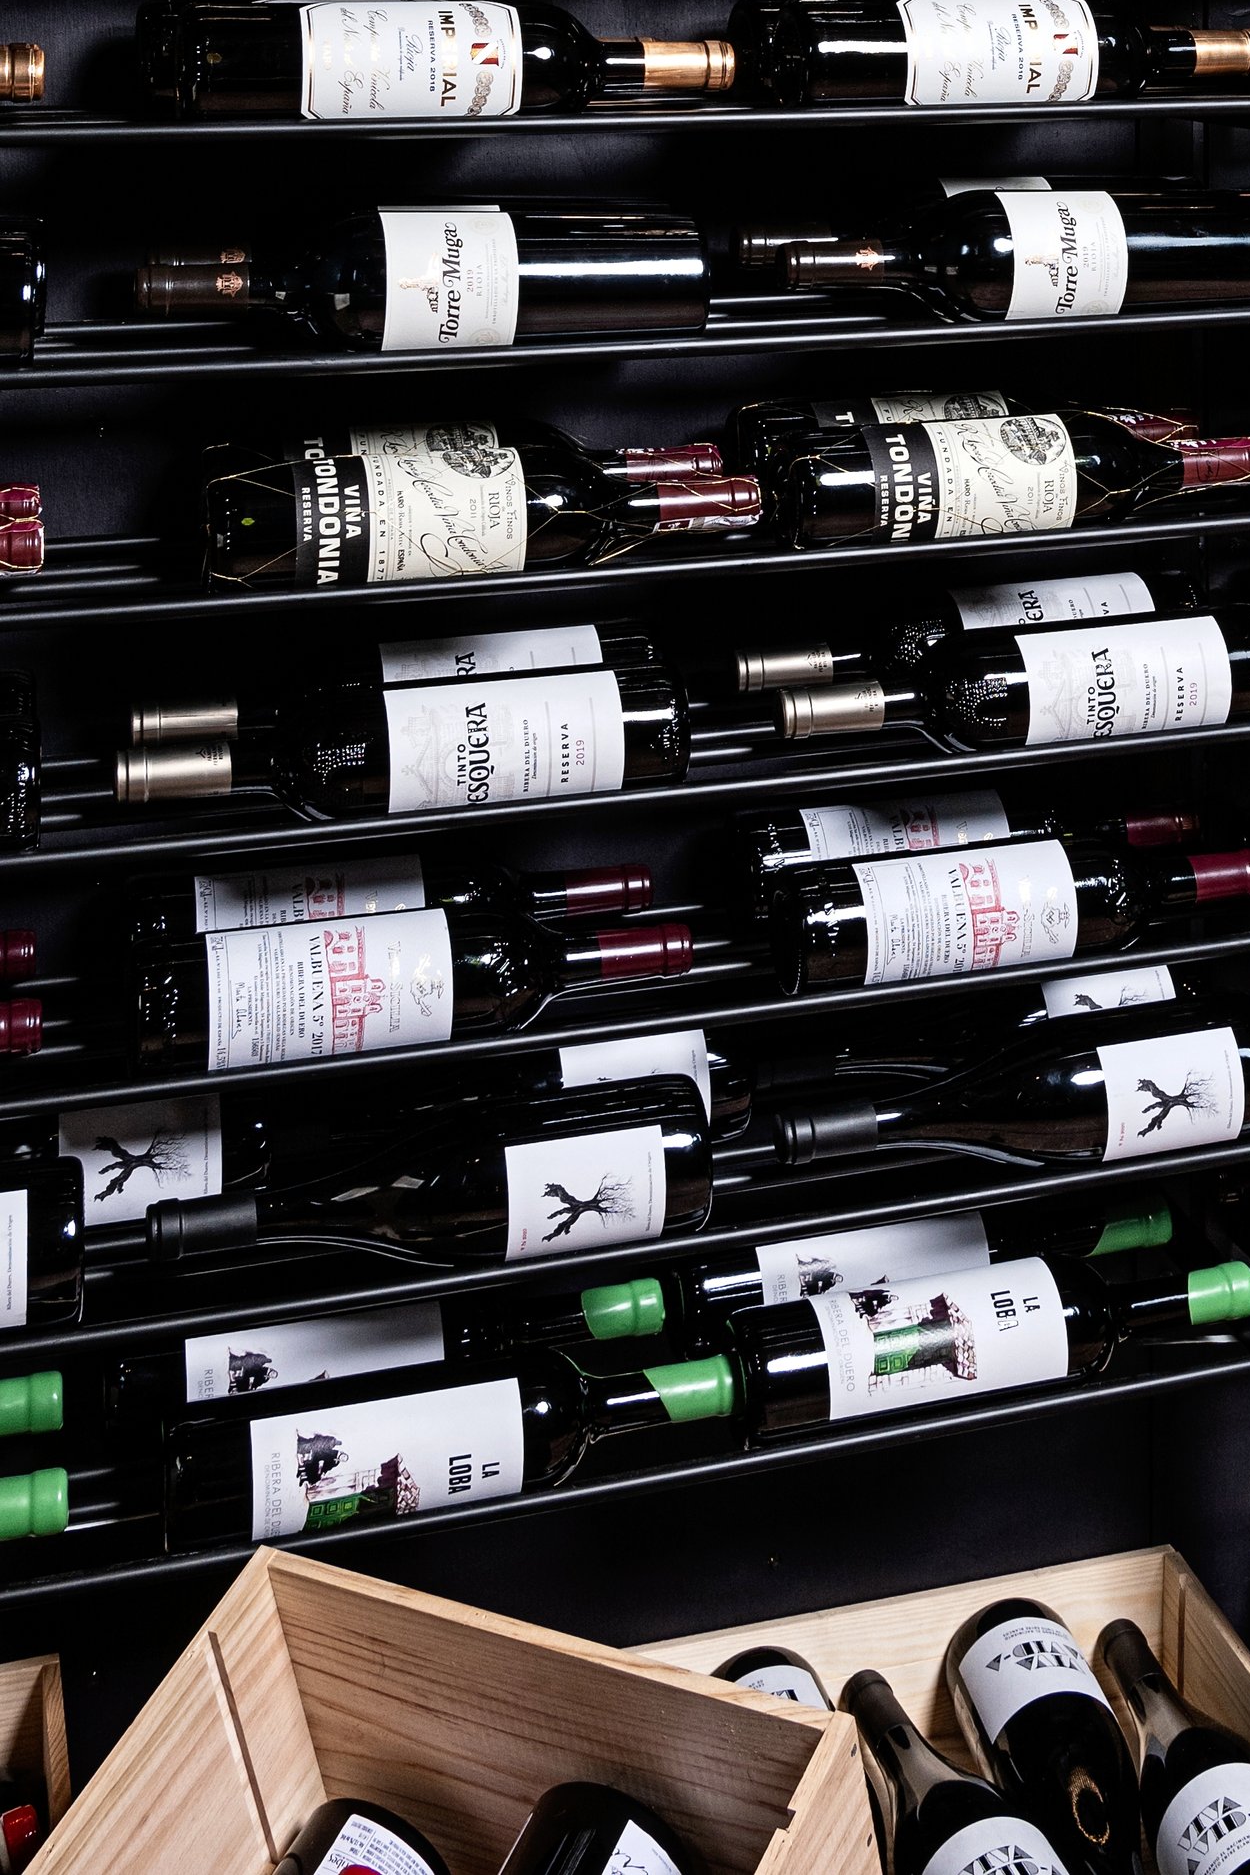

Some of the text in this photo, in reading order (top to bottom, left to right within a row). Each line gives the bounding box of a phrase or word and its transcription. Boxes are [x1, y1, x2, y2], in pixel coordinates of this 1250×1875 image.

[427, 20, 437, 64] RESERVA
[1011, 14, 1023, 55] RESERVA
[1056, 202, 1078, 314] Torre Muga
[439, 222, 464, 344] Torre Muga
[301, 487, 312, 541] RESERVA
[344, 485, 362, 539] VIÑA
[469, 498, 477, 519] 2011
[488, 491, 500, 528] RIOJA
[879, 475, 888, 526] RESERVA
[916, 473, 934, 523] VIÑA
[1043, 480, 1054, 513] RIOJA
[317, 458, 340, 584] TONDONIA
[376, 550, 386, 581] 1877
[1086, 686, 1095, 725] TINTO
[1091, 647, 1121, 736] ESQUERA
[1175, 667, 1184, 721] RESERVA
[1188, 682, 1198, 706] 2019
[463, 702, 495, 803] ESQUERA
[522, 719, 530, 747] DUERO
[560, 723, 570, 783] RESERVA
[575, 739, 585, 766] 2019
[456, 743, 466, 785] TINTO
[947, 869, 966, 940] VALBUENA
[310, 936, 324, 1011] VALBUENA
[298, 1011, 306, 1038] DUERO
[1022, 1297, 1040, 1312] LA
[270, 1452, 283, 1519] RIBERA DEL
[447, 1454, 472, 1495] LOBA
[481, 1462, 500, 1480] LA
